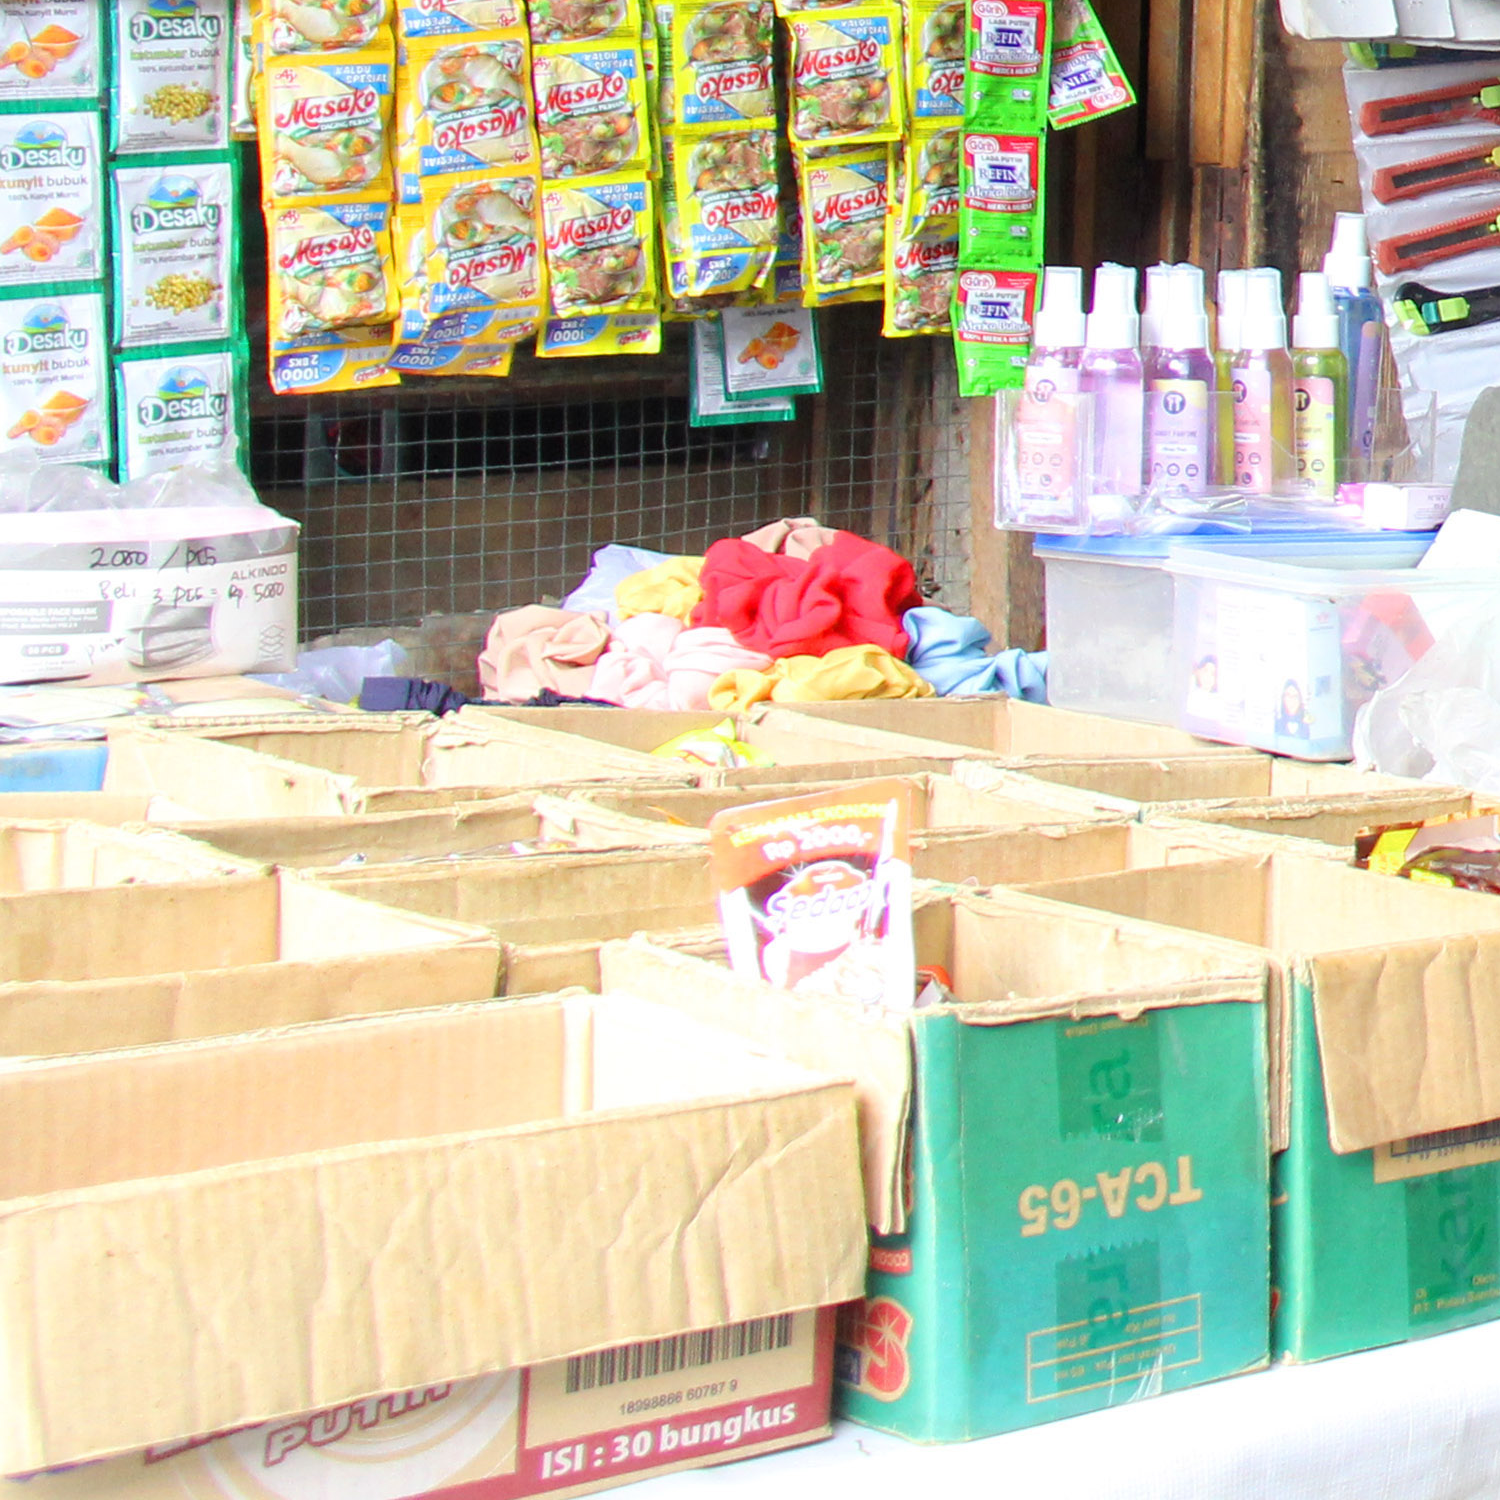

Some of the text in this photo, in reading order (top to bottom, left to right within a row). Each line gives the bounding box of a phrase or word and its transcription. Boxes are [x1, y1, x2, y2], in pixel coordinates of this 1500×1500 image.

[986, 31, 1032, 47] REFINA
[275, 88, 375, 129] Masako
[437, 106, 527, 149] Masako
[979, 168, 1027, 183] REFINA
[279, 225, 373, 268] Masako
[1018, 1155, 1204, 1238] TCA-65
[541, 1403, 797, 1480] ISI 30 bungkus
